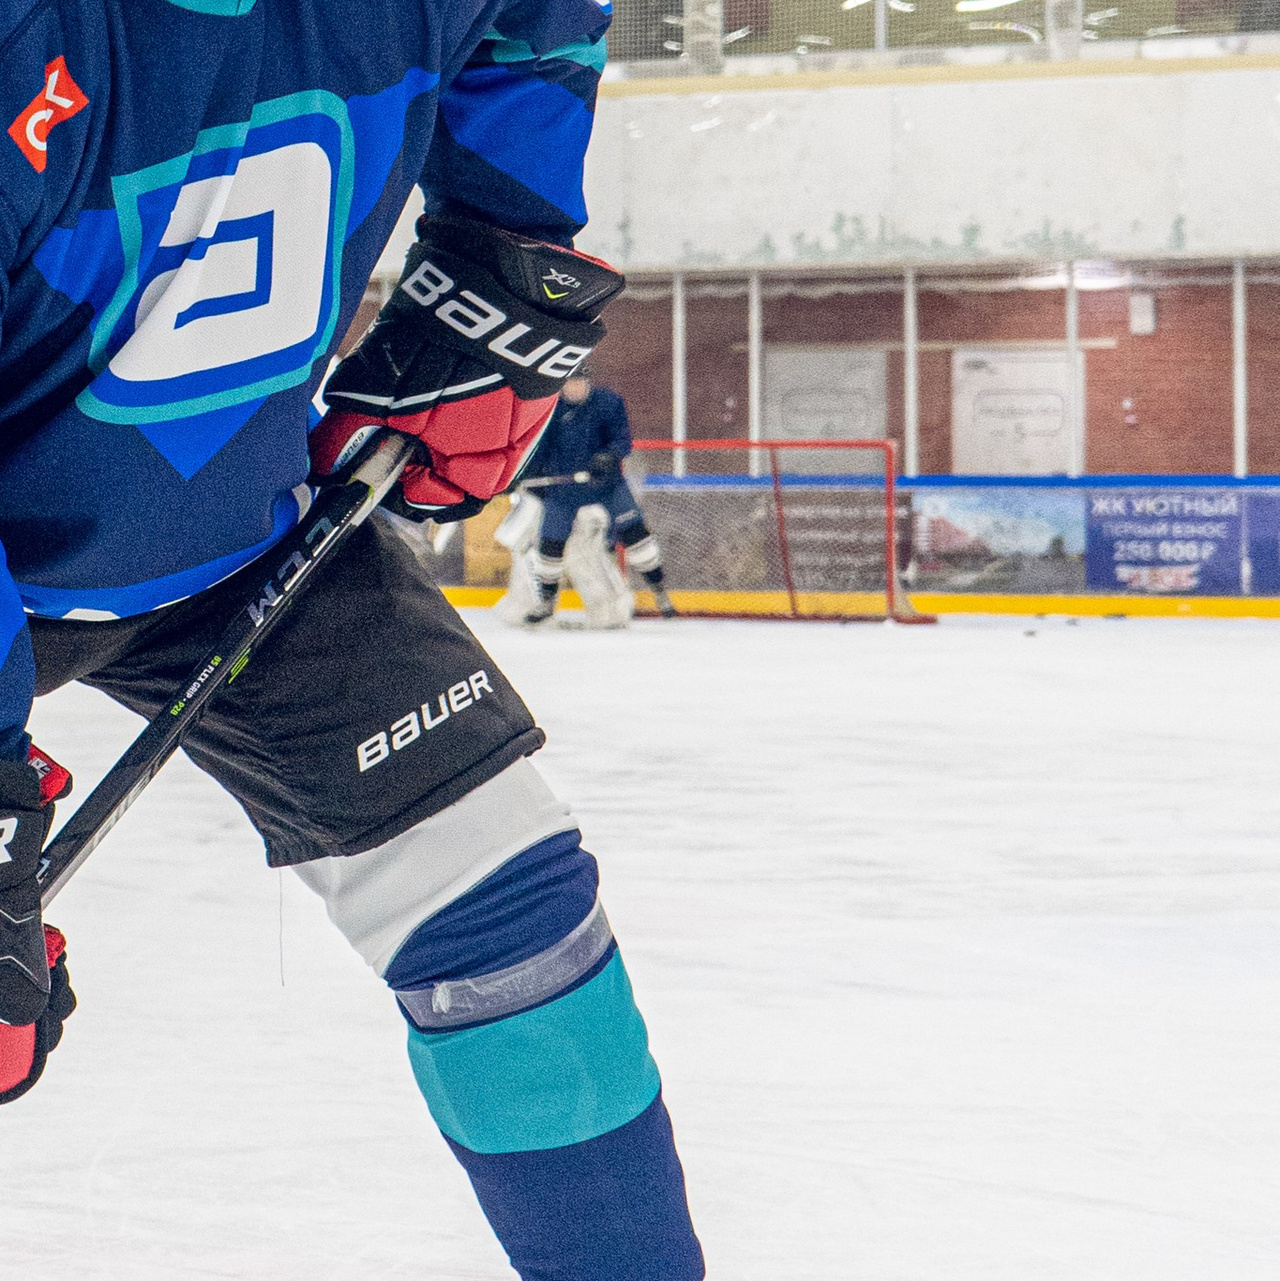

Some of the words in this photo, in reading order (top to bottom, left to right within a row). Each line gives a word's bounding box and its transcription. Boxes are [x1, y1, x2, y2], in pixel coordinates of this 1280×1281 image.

[1132, 494, 1238, 516] УЮТНЫЙ
[247, 517, 340, 628] CCM
[197, 665, 215, 683] FLEX
[186, 681, 201, 699] GRIP
[357, 669, 494, 772] BAUER
